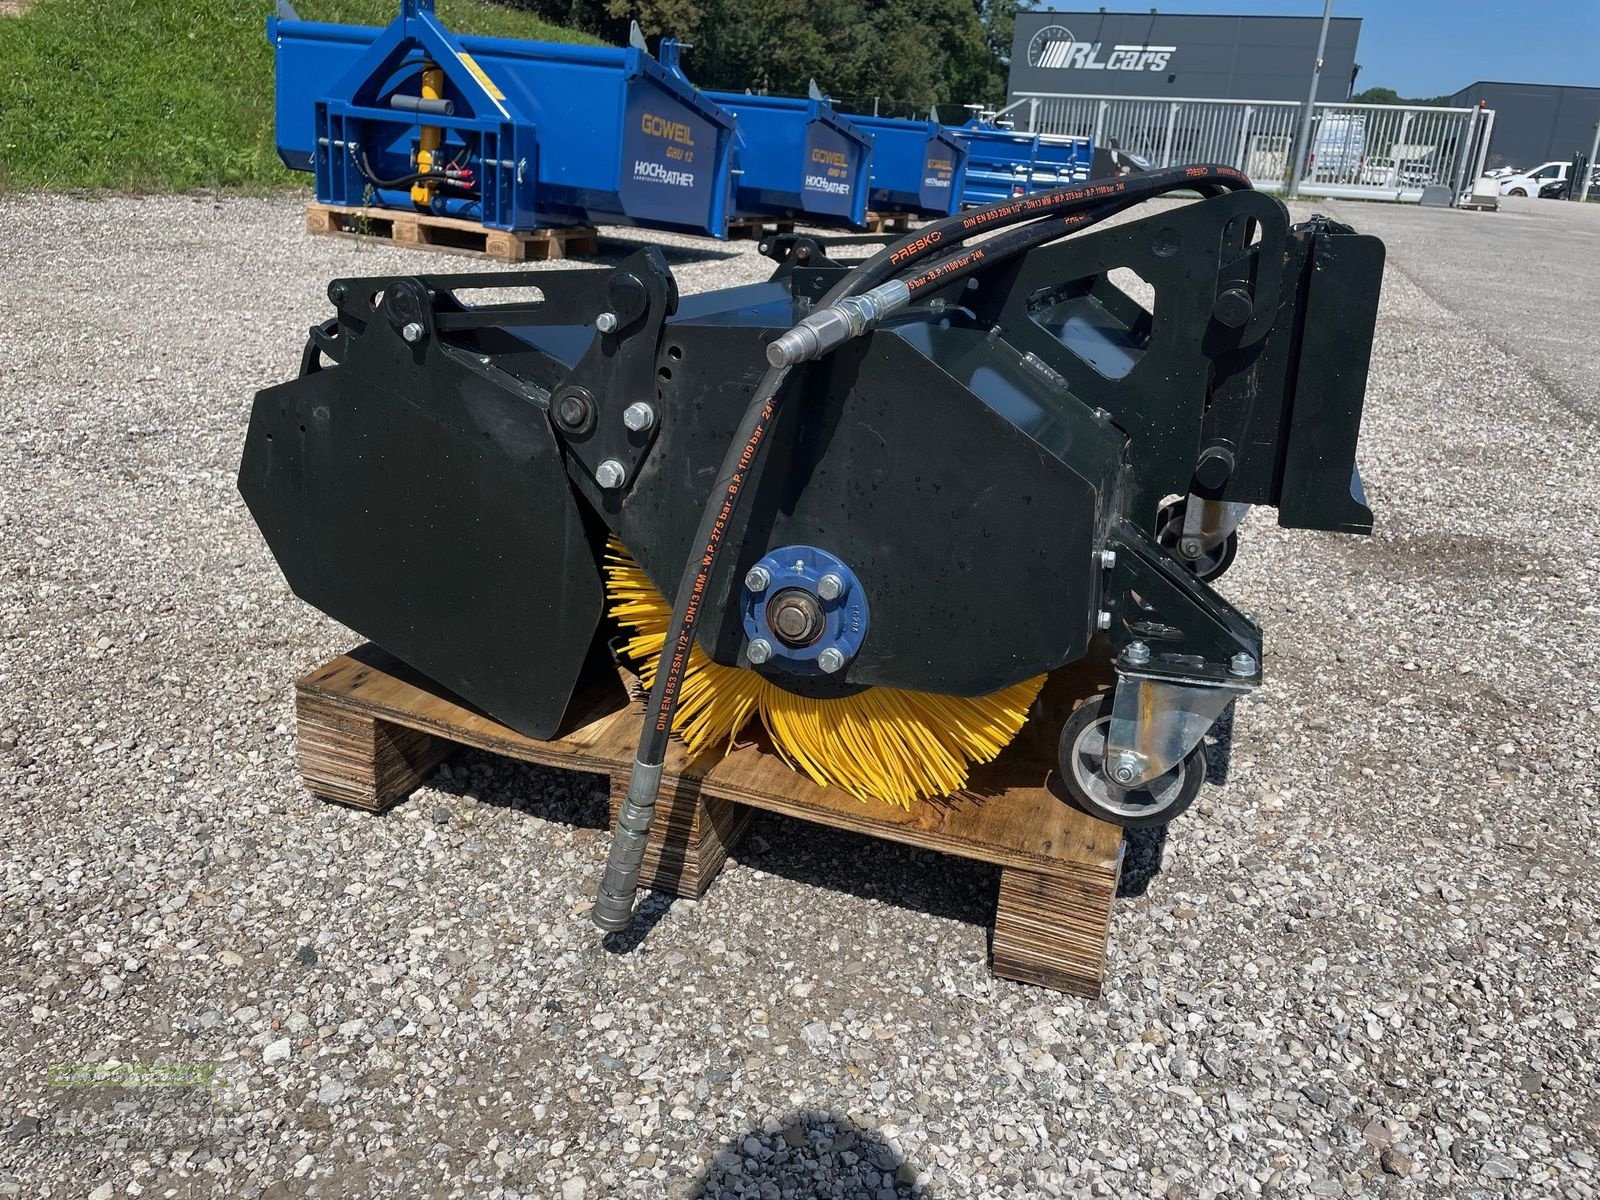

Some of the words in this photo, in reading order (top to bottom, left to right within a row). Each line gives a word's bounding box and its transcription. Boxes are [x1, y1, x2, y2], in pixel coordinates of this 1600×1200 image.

[1106, 50, 1172, 71] cars
[684, 151, 694, 163] 12
[889, 231, 942, 266] PRESKO
[963, 219, 976, 229] DIN
[976, 215, 987, 224] EN
[986, 210, 999, 221] 853
[998, 206, 1012, 218] 2SN
[1027, 199, 1042, 210] DN13
[1042, 196, 1052, 206] MM
[1074, 190, 1084, 200] bar
[1106, 184, 1114, 193] bar
[914, 276, 926, 287] bar
[929, 268, 945, 280] B.P.
[943, 261, 959, 273] 1100
[958, 256, 969, 267] bar
[970, 249, 985, 261] 24K
[761, 398, 777, 421] 24K
[749, 424, 764, 445] bar
[738, 445, 754, 471] 1100
[728, 473, 744, 494] B.P.
[718, 500, 732, 520] bar
[711, 520, 725, 542] 275
[702, 543, 719, 567] W.P.
[693, 573, 706, 593] MM
[684, 593, 700, 624] DN13
[677, 630, 689, 651] 1/2"
[671, 653, 684, 676] 2SN
[665, 675, 678, 694] 853
[660, 695, 672, 712] EN
[656, 711, 668, 731] DIN
